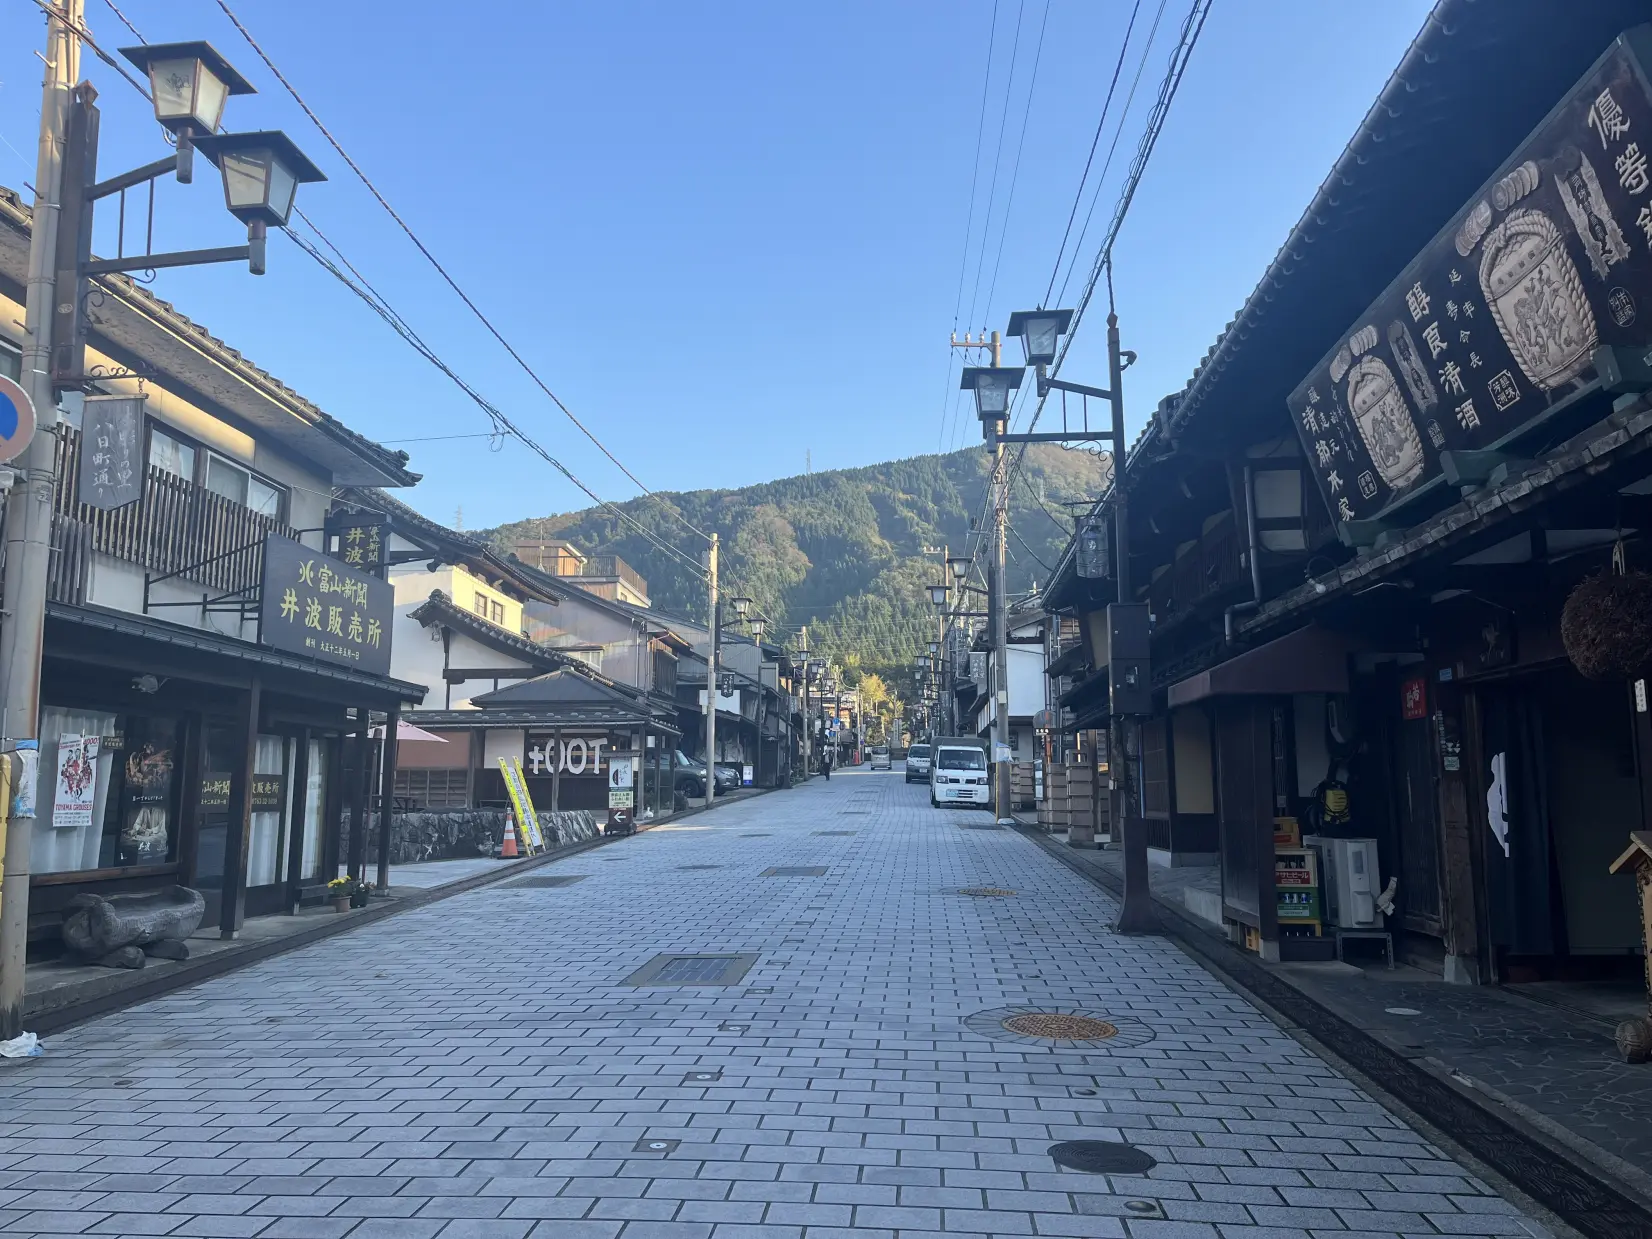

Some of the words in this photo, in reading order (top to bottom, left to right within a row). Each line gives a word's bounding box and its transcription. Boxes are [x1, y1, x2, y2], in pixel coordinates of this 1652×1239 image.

[345, 527, 366, 569] 井波
[366, 523, 381, 563] 富山新聞
[318, 563, 368, 610] 富山新聞
[279, 588, 382, 649] 井波販売所
[55, 803, 72, 811] TOYAMA
[73, 803, 92, 811] GROUSES
